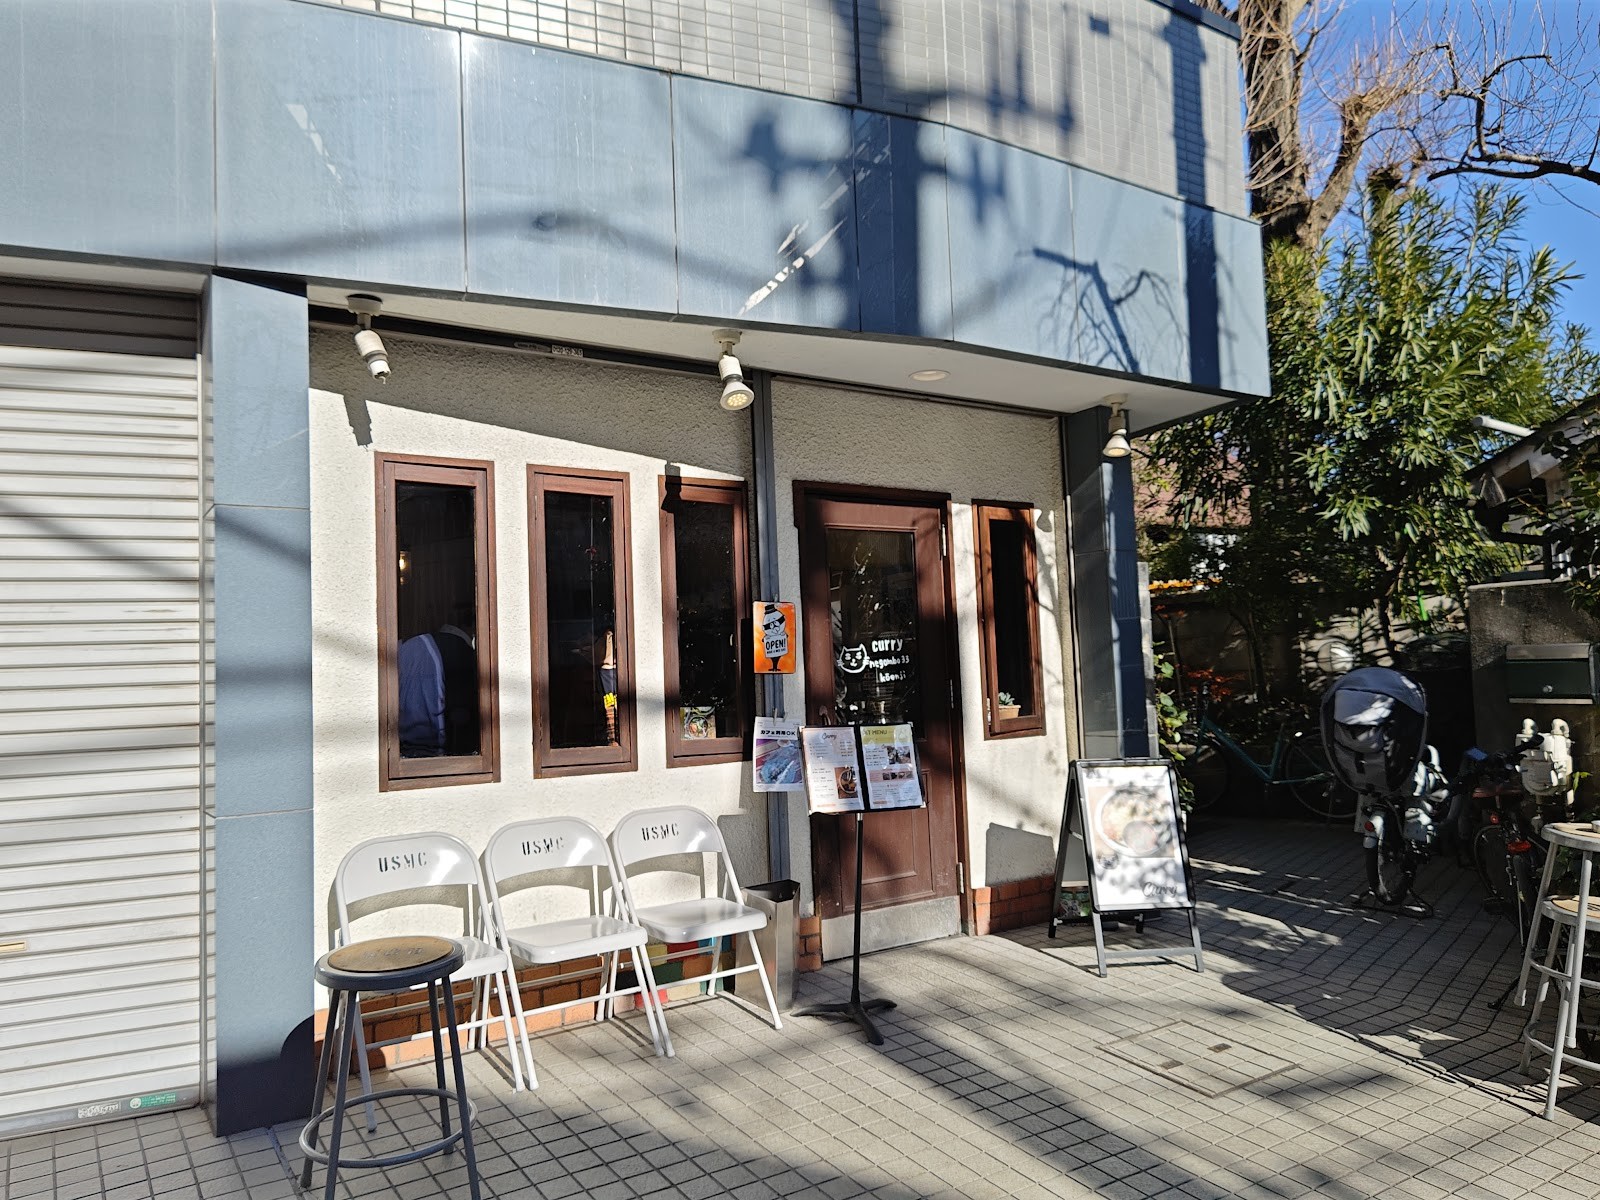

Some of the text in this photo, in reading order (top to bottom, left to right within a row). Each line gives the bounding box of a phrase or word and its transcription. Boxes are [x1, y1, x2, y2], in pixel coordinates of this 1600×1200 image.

[766, 638, 786, 650] OPEN!
[871, 639, 903, 652] curry
[641, 822, 680, 841] USMC
[521, 836, 565, 856] USMC
[378, 852, 428, 873] USMC
[1143, 881, 1178, 898] Curry
